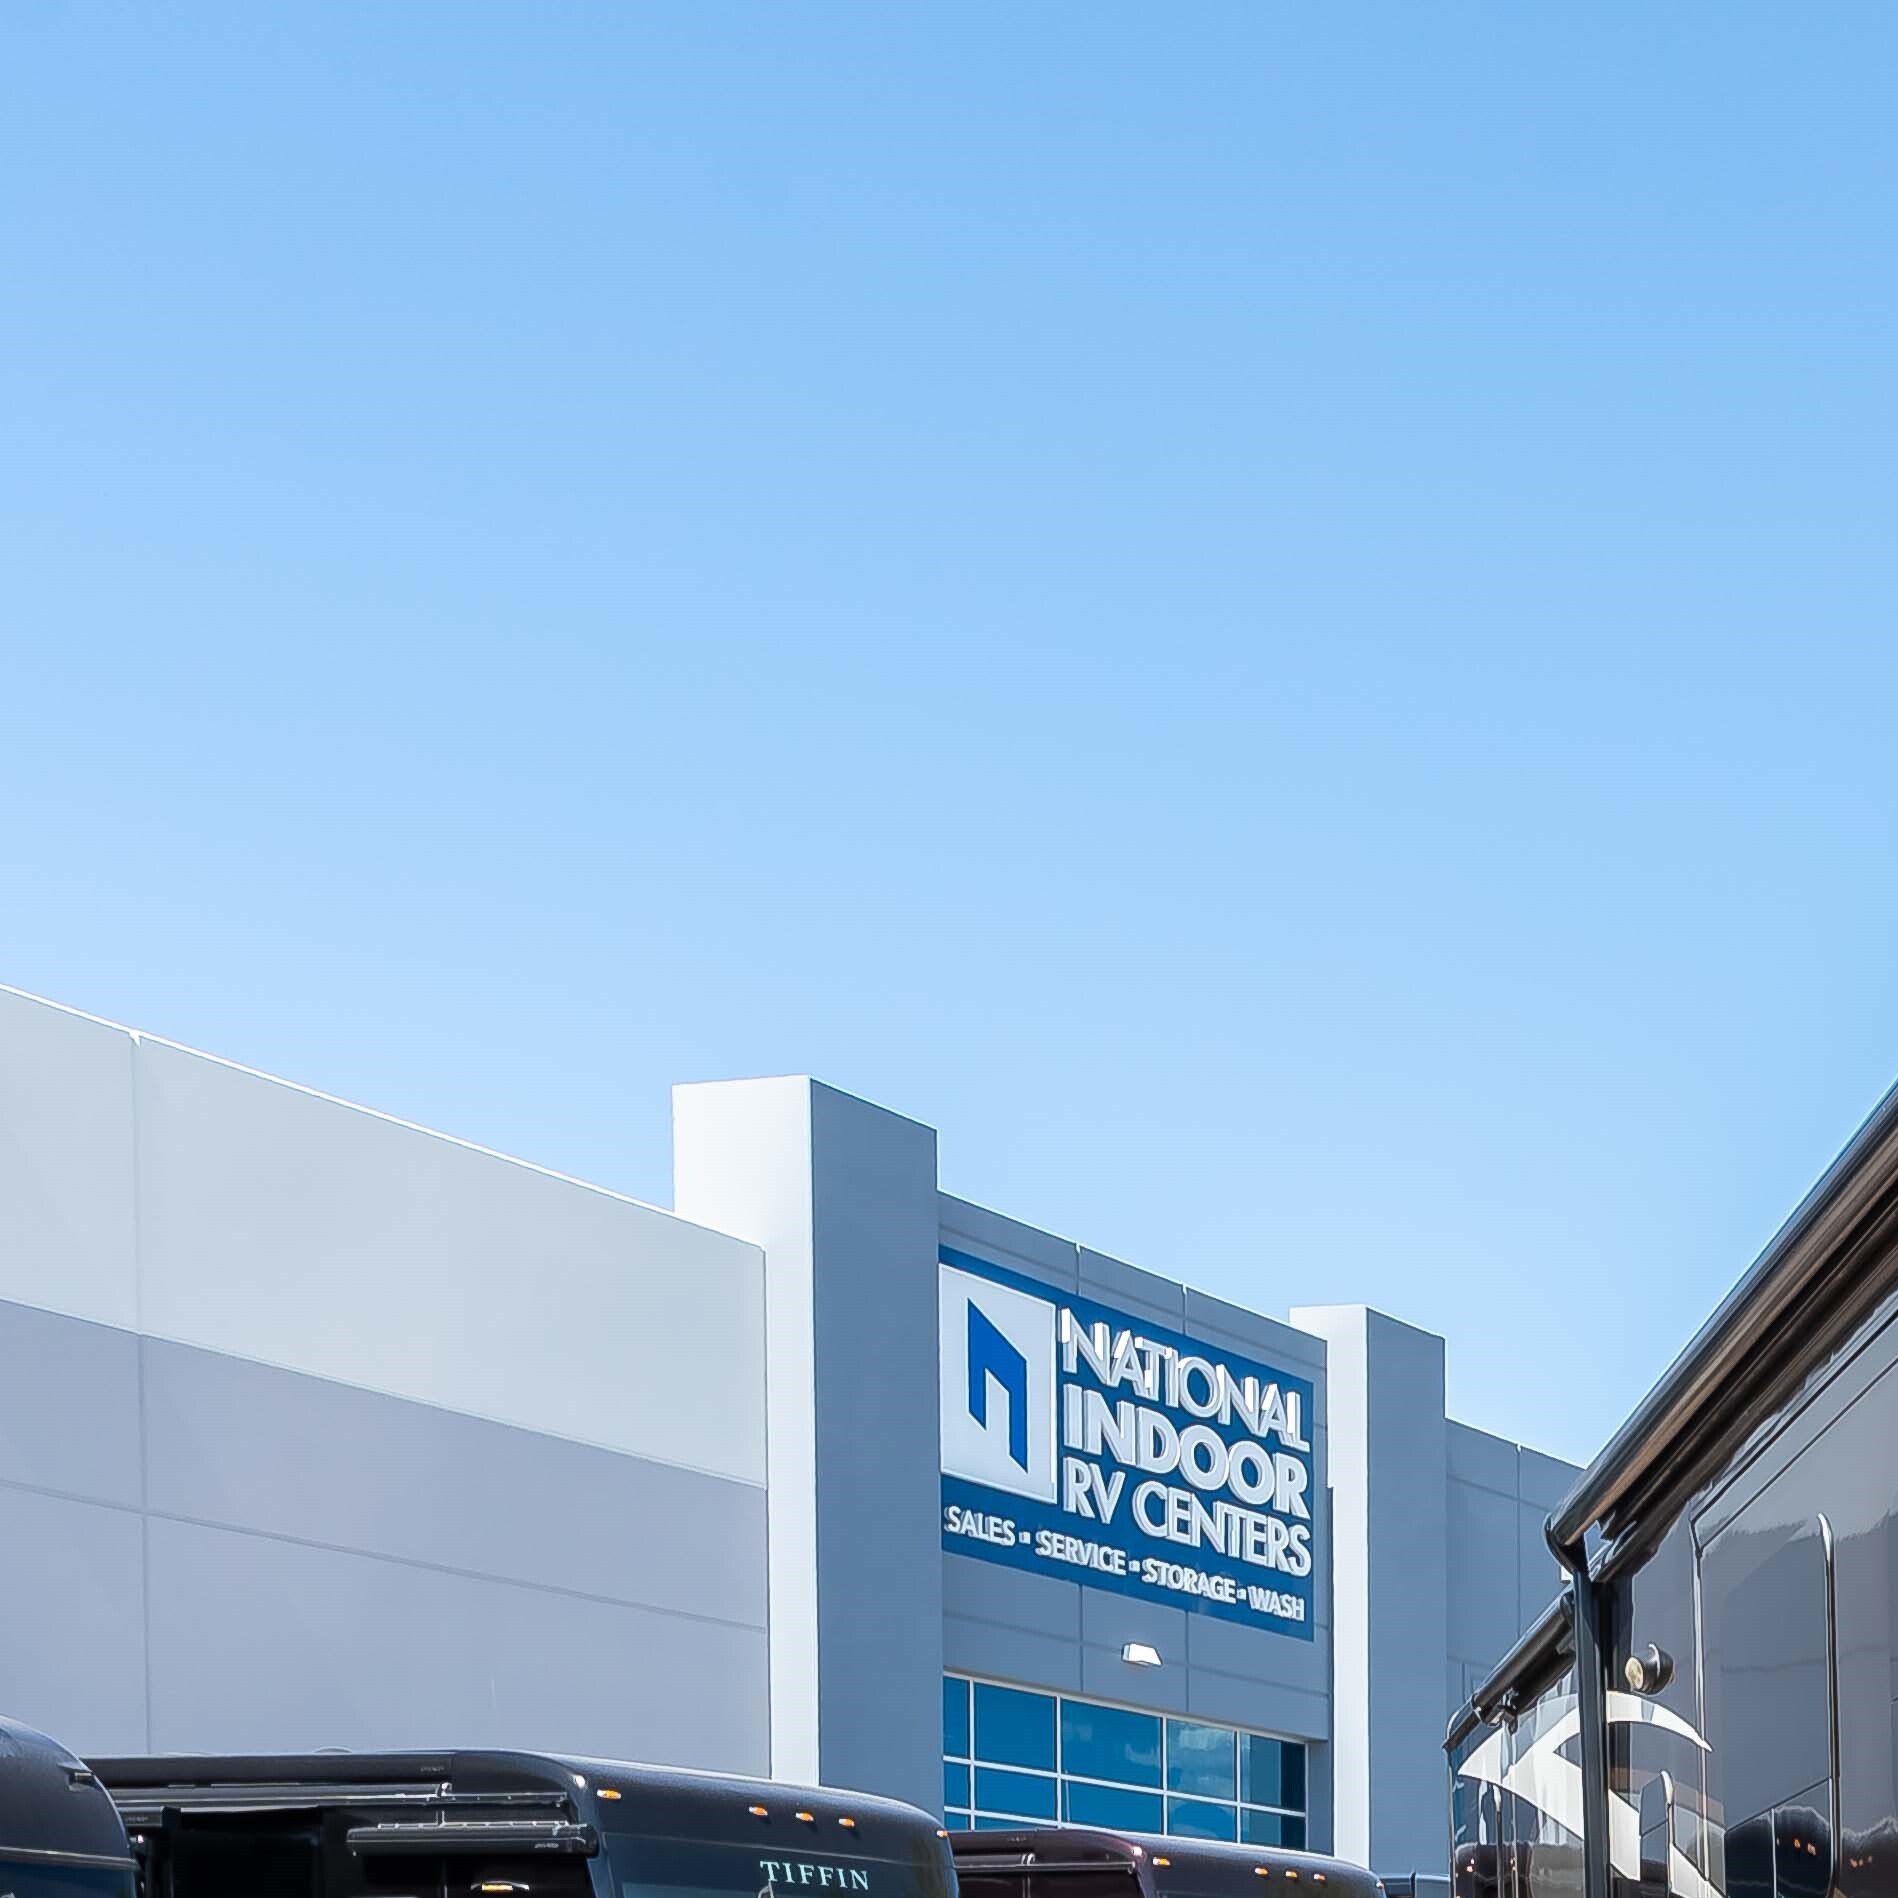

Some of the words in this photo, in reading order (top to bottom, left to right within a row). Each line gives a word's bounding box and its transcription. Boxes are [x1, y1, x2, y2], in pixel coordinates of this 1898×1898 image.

[1060, 1307, 1310, 1453] NATIONAL
[1063, 1383, 1310, 1519] INDOOR
[944, 1505, 1016, 1546] SALES
[1035, 1530, 1127, 1576] SERVICE
[1142, 1558, 1237, 1604] STORAGE
[1248, 1586, 1305, 1621] WASH
[1063, 1456, 1125, 1524] RV
[1132, 1481, 1312, 1577] CENTERS
[760, 1860, 869, 1890] TIFFIN
